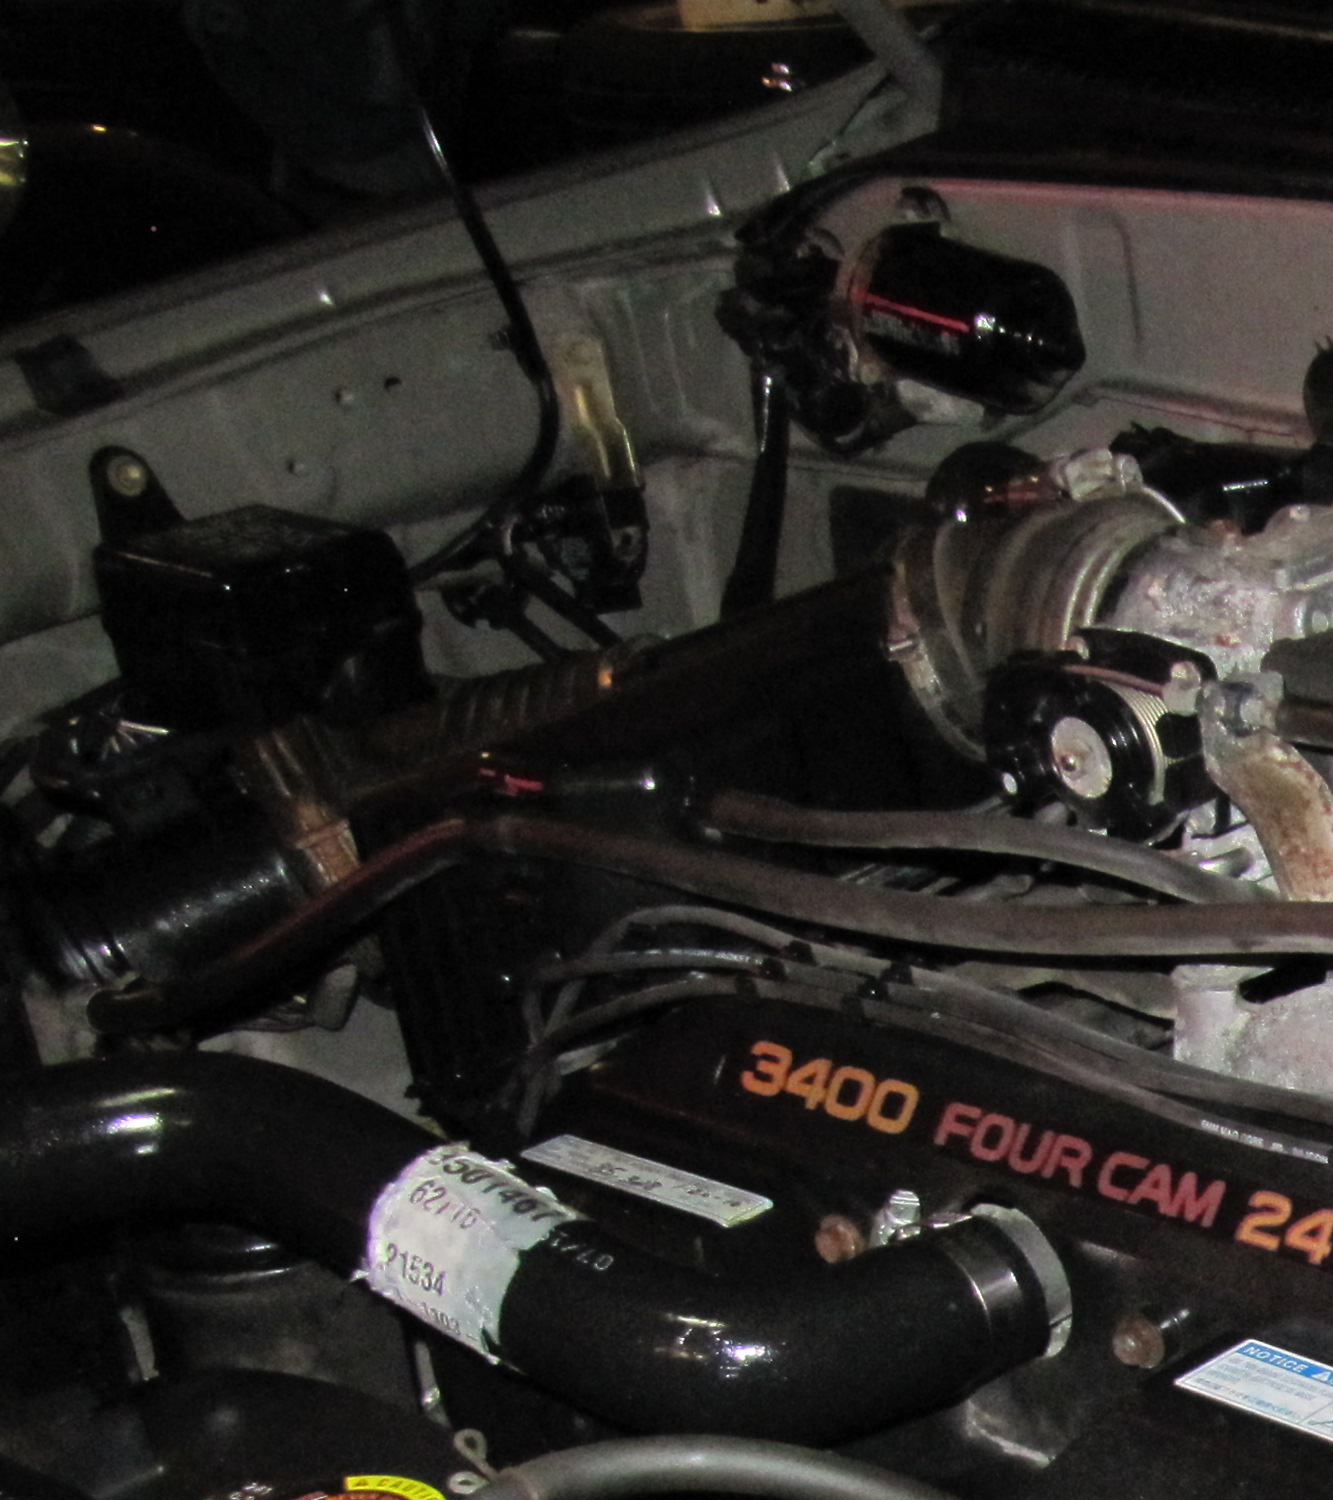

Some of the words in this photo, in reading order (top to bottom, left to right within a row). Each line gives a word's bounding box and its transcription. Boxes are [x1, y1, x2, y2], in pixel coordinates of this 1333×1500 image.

[740, 1040, 919, 1134] 3400
[934, 1101, 1092, 1188] FOUR
[1097, 1150, 1227, 1228] CAM
[1244, 1347, 1309, 1374] NOTICE
